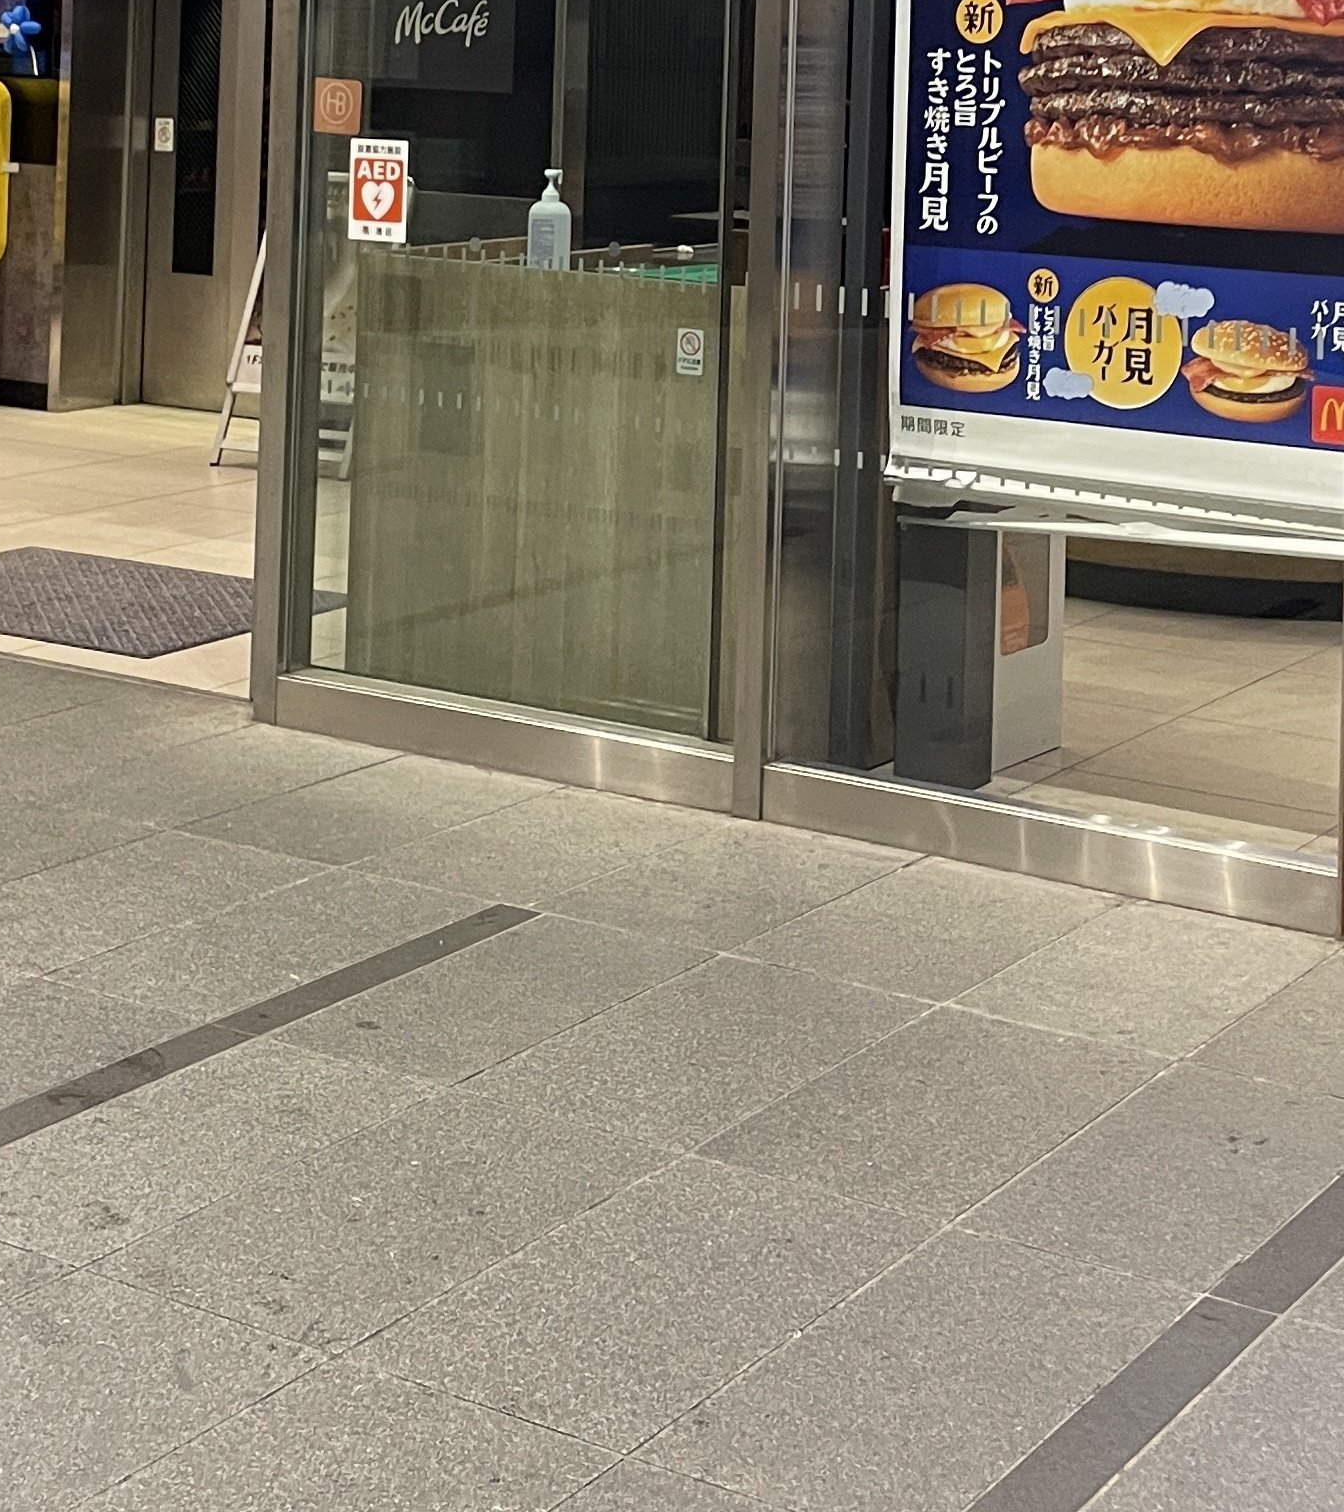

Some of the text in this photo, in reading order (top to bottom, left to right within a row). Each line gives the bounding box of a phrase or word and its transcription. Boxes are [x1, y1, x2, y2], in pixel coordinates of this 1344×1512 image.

[964, 1, 994, 35] 新
[953, 48, 977, 127] とろ旨
[357, 160, 401, 181] AED
[918, 48, 951, 232] すき焼き月見
[976, 49, 1006, 236] トリプルビーフの
[1034, 274, 1053, 298] 新
[1092, 303, 1120, 381] バーガー
[1121, 306, 1154, 385] 月見
[901, 415, 966, 438] 期間限定
